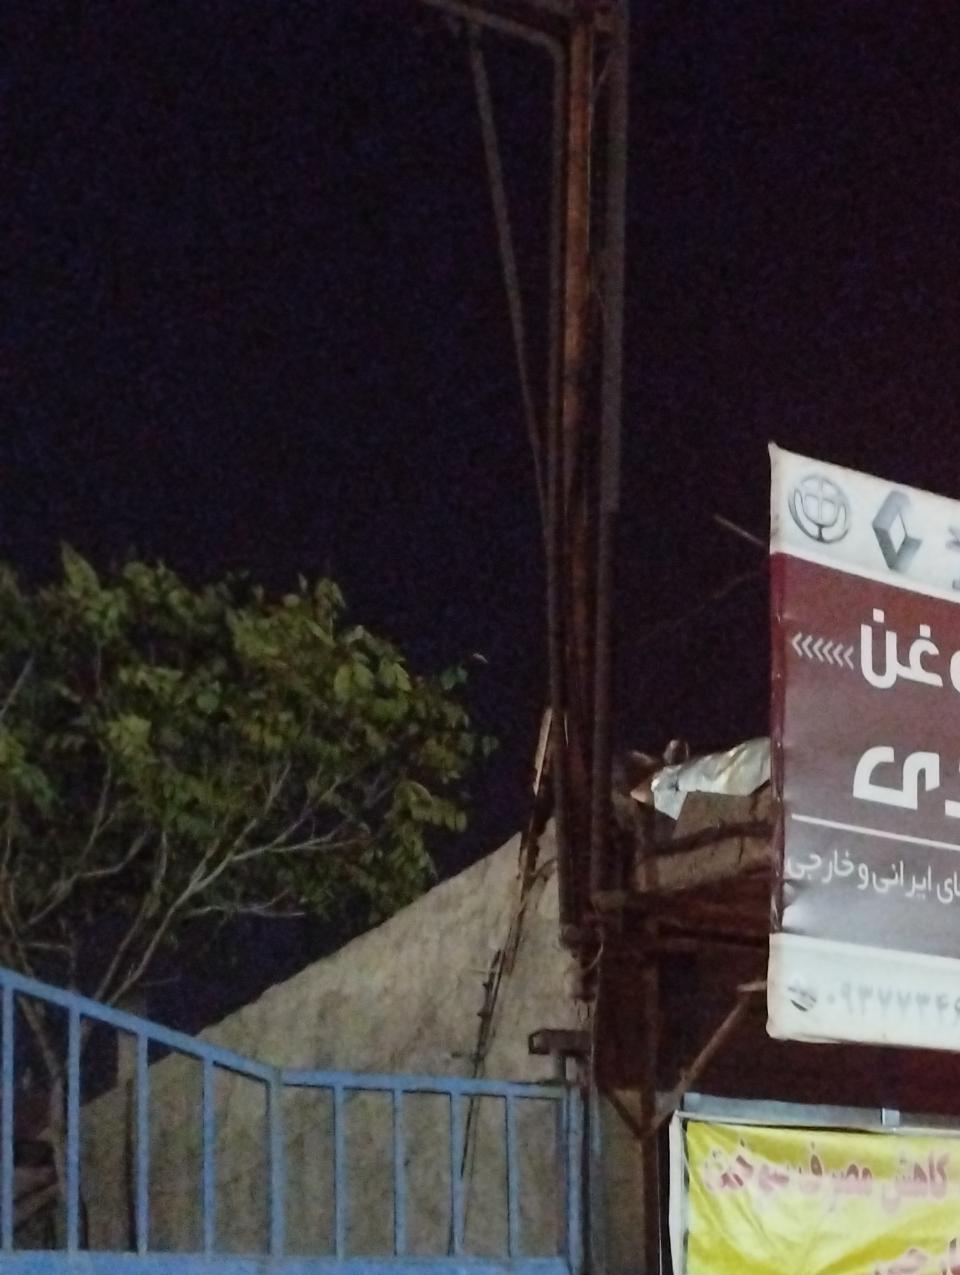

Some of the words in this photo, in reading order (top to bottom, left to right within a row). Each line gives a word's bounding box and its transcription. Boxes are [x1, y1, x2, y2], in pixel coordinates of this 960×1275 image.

[786, 850, 854, 884] خارجی
[857, 862, 870, 890] و
[872, 860, 932, 899] ایرانی
